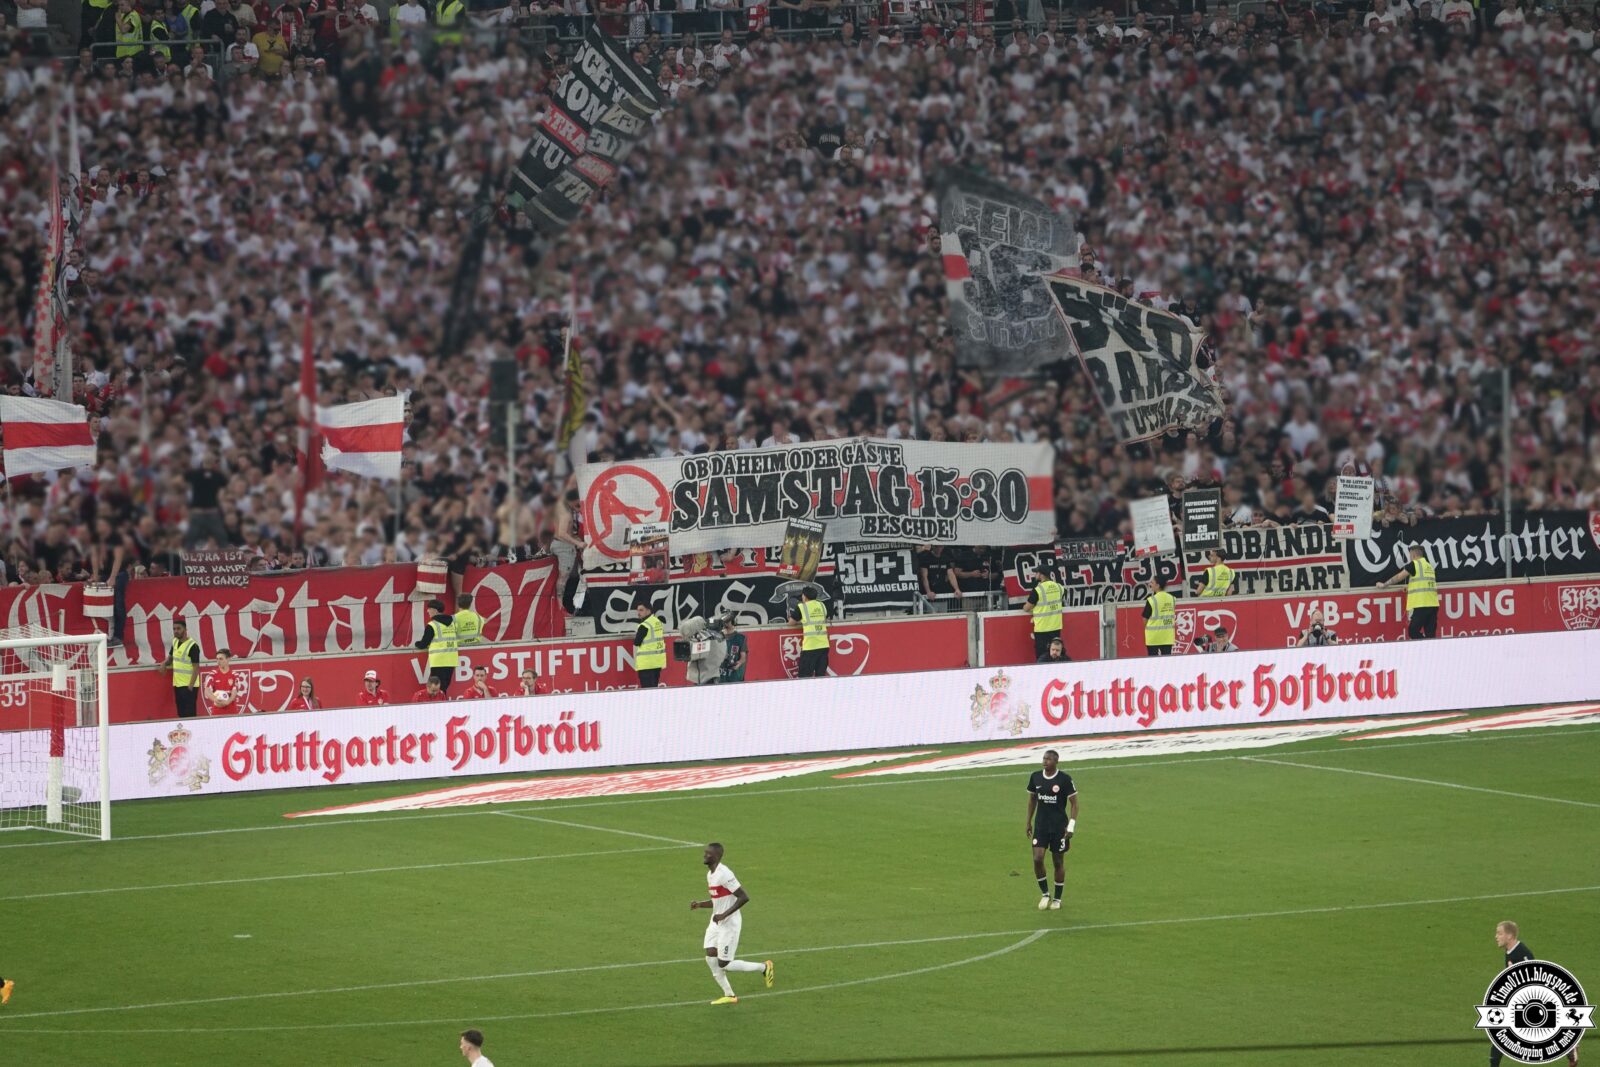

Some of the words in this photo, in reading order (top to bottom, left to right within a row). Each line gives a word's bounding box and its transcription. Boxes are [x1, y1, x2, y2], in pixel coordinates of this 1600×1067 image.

[683, 459, 709, 480] OB
[711, 451, 788, 476] DAHEIM
[792, 446, 839, 471] ODER
[671, 464, 912, 530] SAMSTAG
[916, 468, 1029, 524] 15:30
[862, 515, 955, 541] BESCHDE!
[1185, 531, 1219, 542] REICHT!
[1197, 524, 1208, 533] ES
[182, 551, 220, 562] ULTRA
[224, 550, 245, 561] IST
[1185, 525, 1343, 564] DBANDE
[185, 564, 208, 574] DER
[212, 564, 247, 573] KAMPF
[188, 575, 211, 586] UMS
[212, 575, 249, 585] GANZE
[837, 550, 918, 585] 50+1
[1041, 672, 1245, 728] Stuttgarter
[1253, 660, 1399, 717] Hofbräu
[222, 725, 438, 783] Stuttgarter
[444, 711, 602, 771] Hofbräu
[1060, 838, 1066, 849] 3
